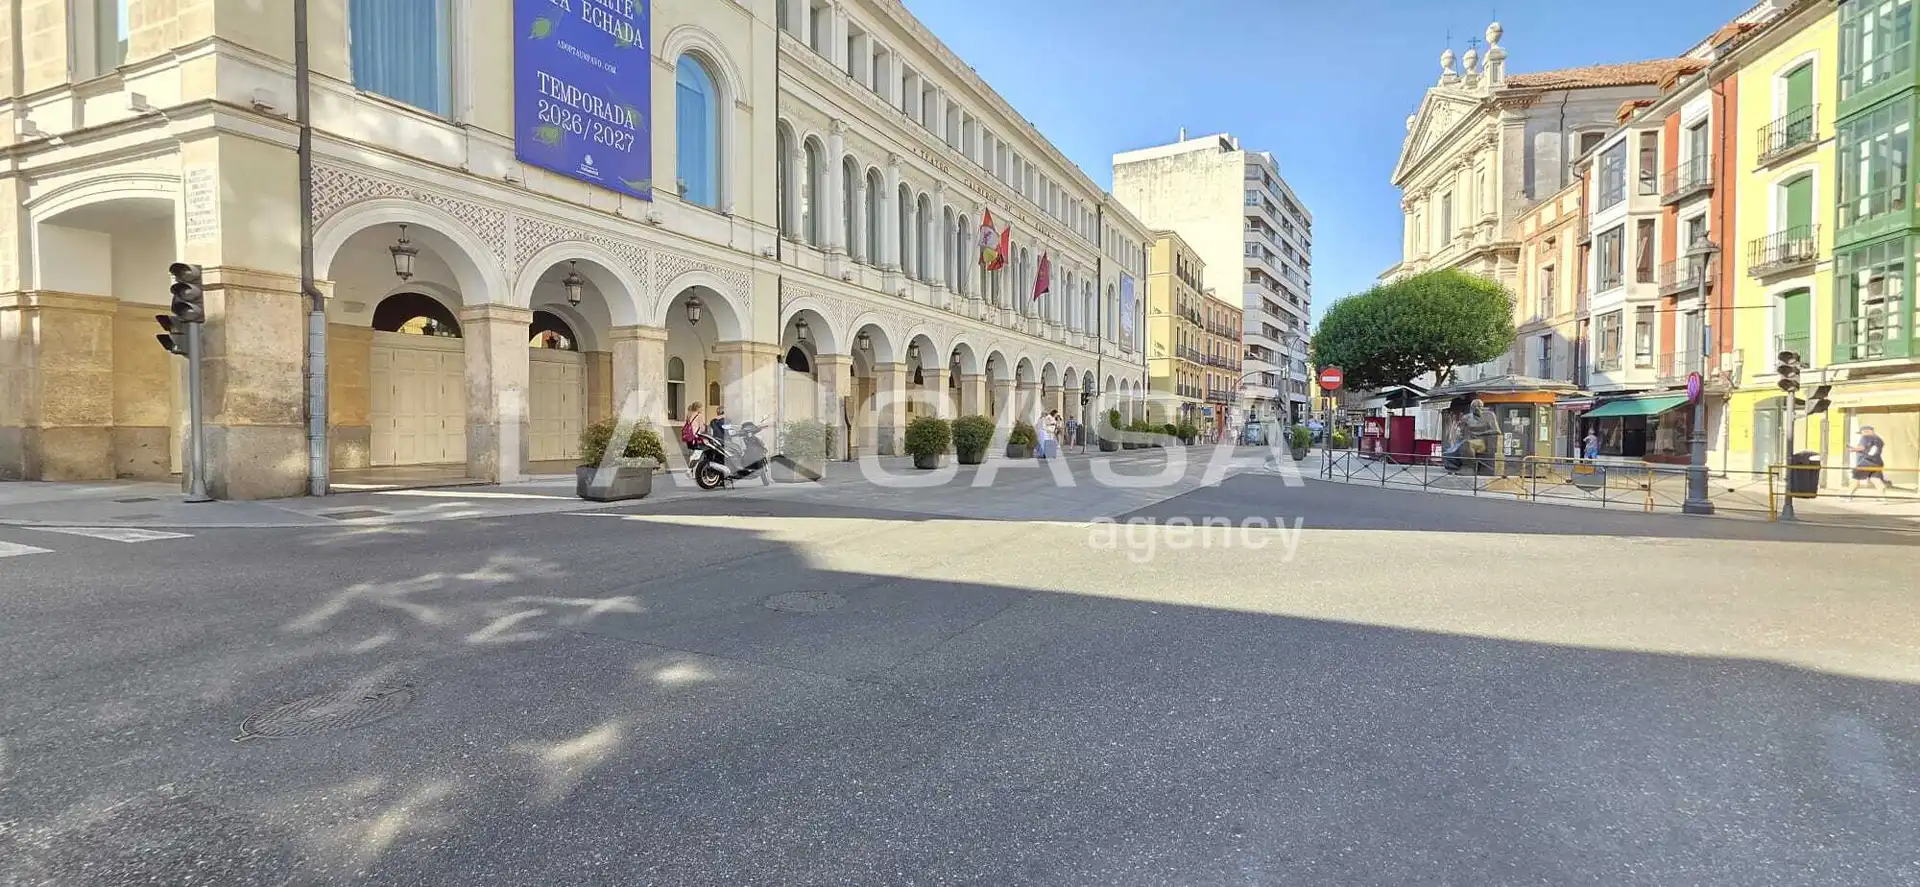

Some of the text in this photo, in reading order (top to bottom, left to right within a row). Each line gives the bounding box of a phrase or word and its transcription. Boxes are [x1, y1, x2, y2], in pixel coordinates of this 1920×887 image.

[582, 0, 644, 50] ECHADA
[537, 70, 635, 130] TEMPORADA
[538, 99, 635, 153] 2026/2027
